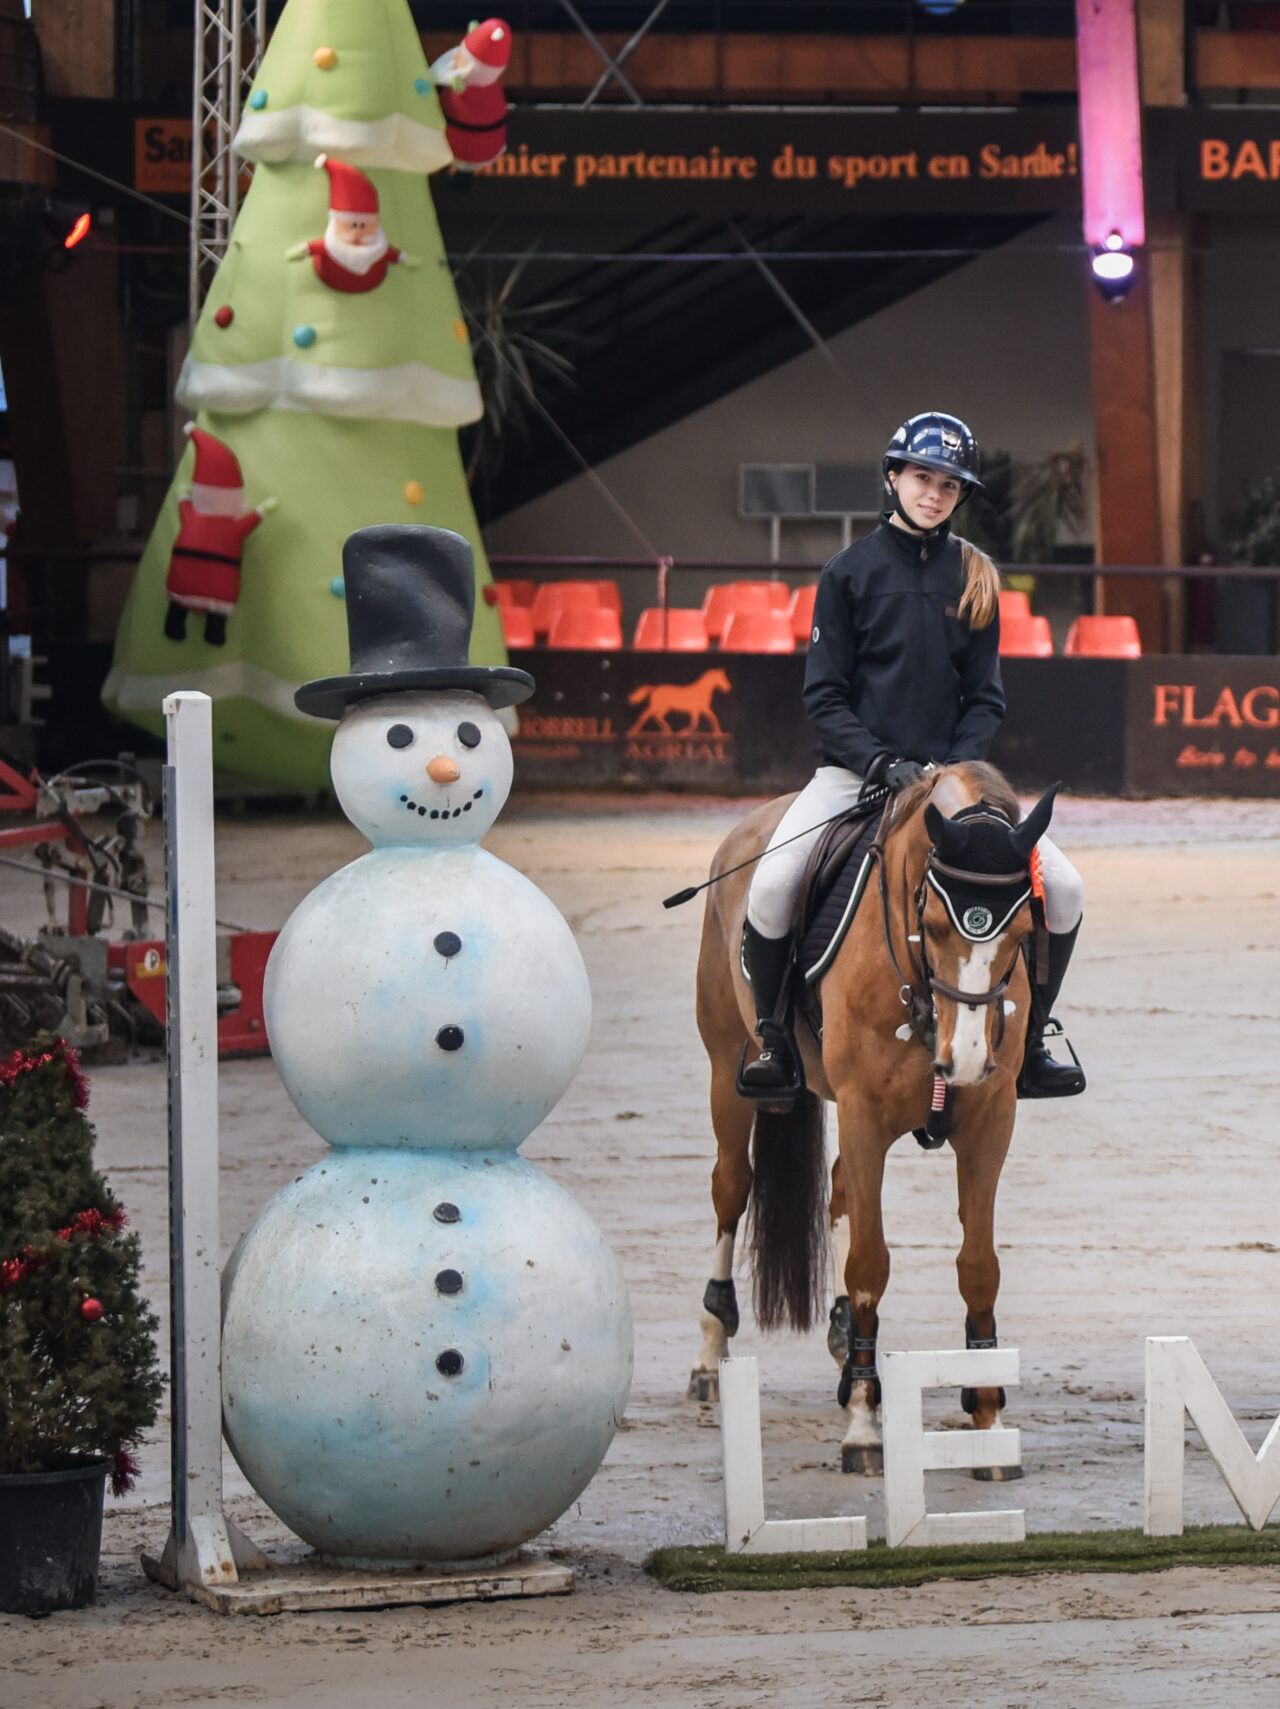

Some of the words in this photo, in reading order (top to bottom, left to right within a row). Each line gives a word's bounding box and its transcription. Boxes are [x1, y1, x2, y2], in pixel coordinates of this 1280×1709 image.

[574, 147, 757, 188] partenaire
[771, 145, 817, 178] du
[827, 152, 917, 188] sport
[927, 155, 970, 178] en
[979, 143, 1077, 178] Sarthe!
[719, 1348, 1026, 1555] LE
